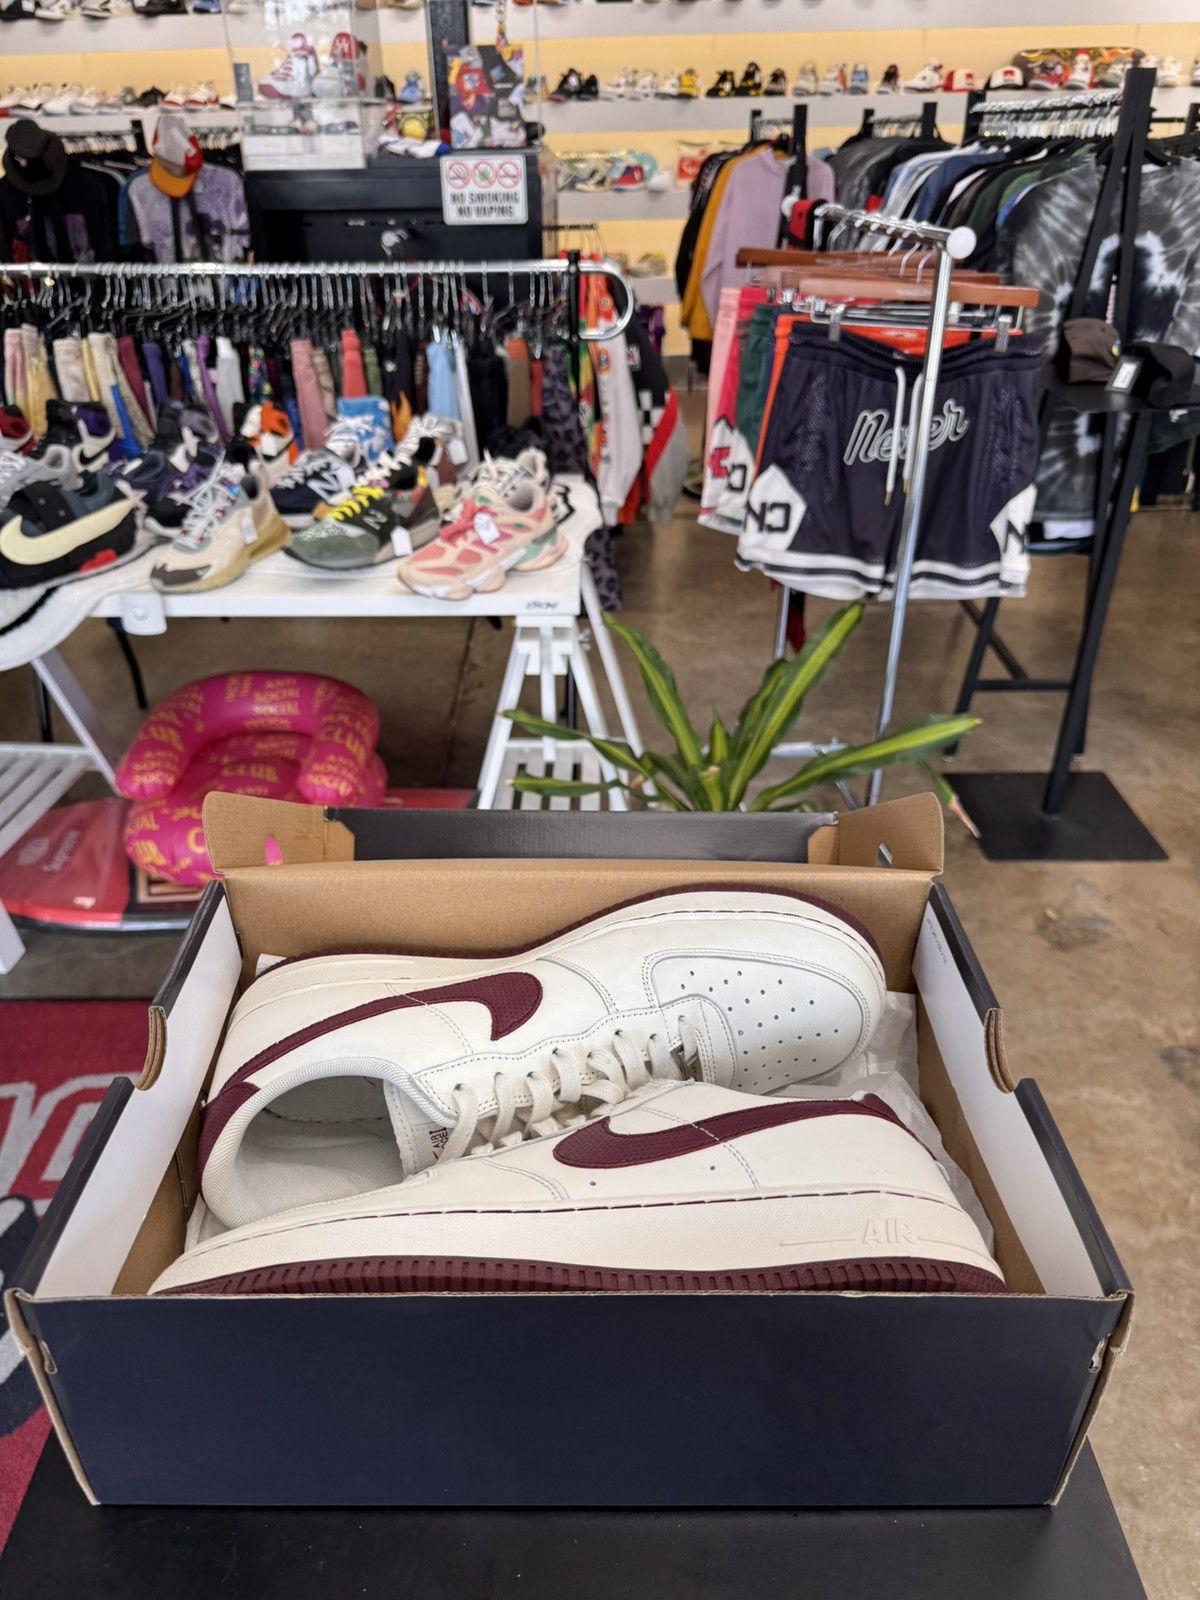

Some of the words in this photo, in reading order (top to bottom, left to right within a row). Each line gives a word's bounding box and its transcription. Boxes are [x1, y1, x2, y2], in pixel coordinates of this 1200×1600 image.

[450, 192, 466, 204] NO
[469, 192, 519, 204] SMOKING
[457, 206, 472, 217] NO
[475, 205, 514, 217] VAPING
[430, 1133, 441, 1149] AIR
[862, 1217, 914, 1245] AIR
